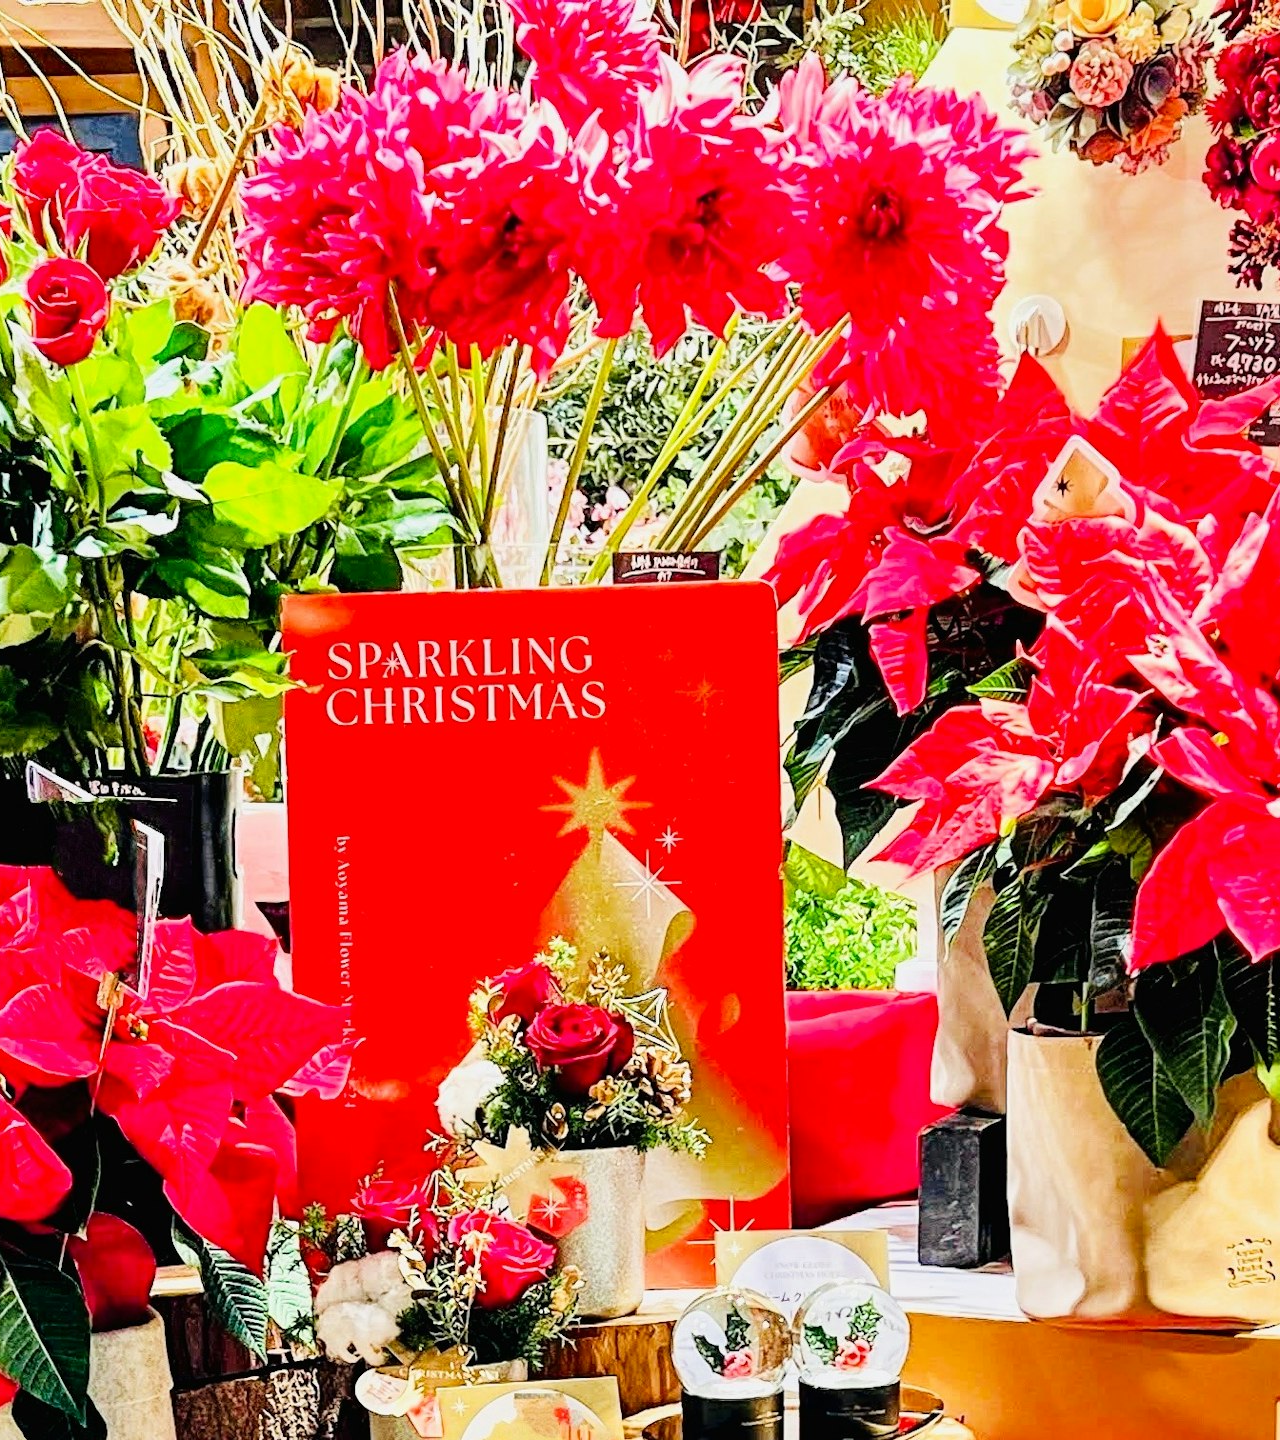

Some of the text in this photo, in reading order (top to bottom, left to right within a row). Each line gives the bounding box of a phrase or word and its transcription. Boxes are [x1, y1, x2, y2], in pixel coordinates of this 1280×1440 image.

[327, 635, 594, 681] SPARKLING
[325, 680, 607, 726] CHRISTMAS
[333, 835, 351, 854] by
[334, 859, 351, 926] Aoyama
[339, 931, 354, 988] Flower
